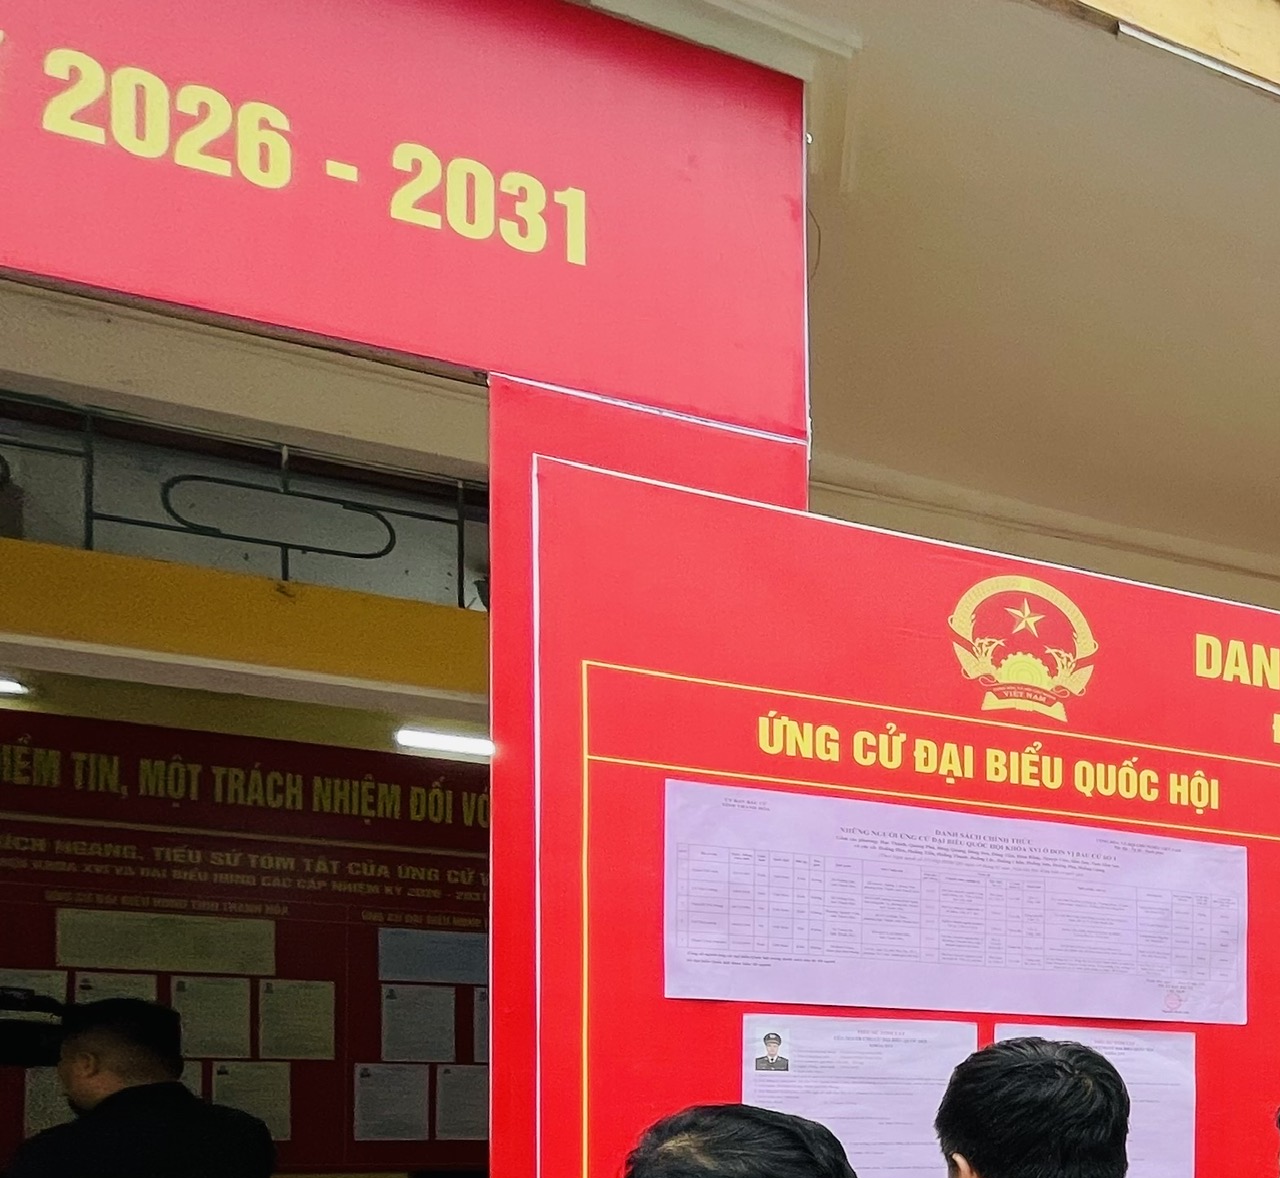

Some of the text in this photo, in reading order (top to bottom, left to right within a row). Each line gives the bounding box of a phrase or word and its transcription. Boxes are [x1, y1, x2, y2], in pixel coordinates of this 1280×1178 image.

[42, 48, 586, 265] 2026 - 2031
[0, 732, 489, 829] IỀM TIN, MỘT TRÁCH NHIỆM ĐỐI VỚ
[759, 711, 1218, 814] ỨNG CỬ ĐẠI BIỂU QUỐC HỘI
